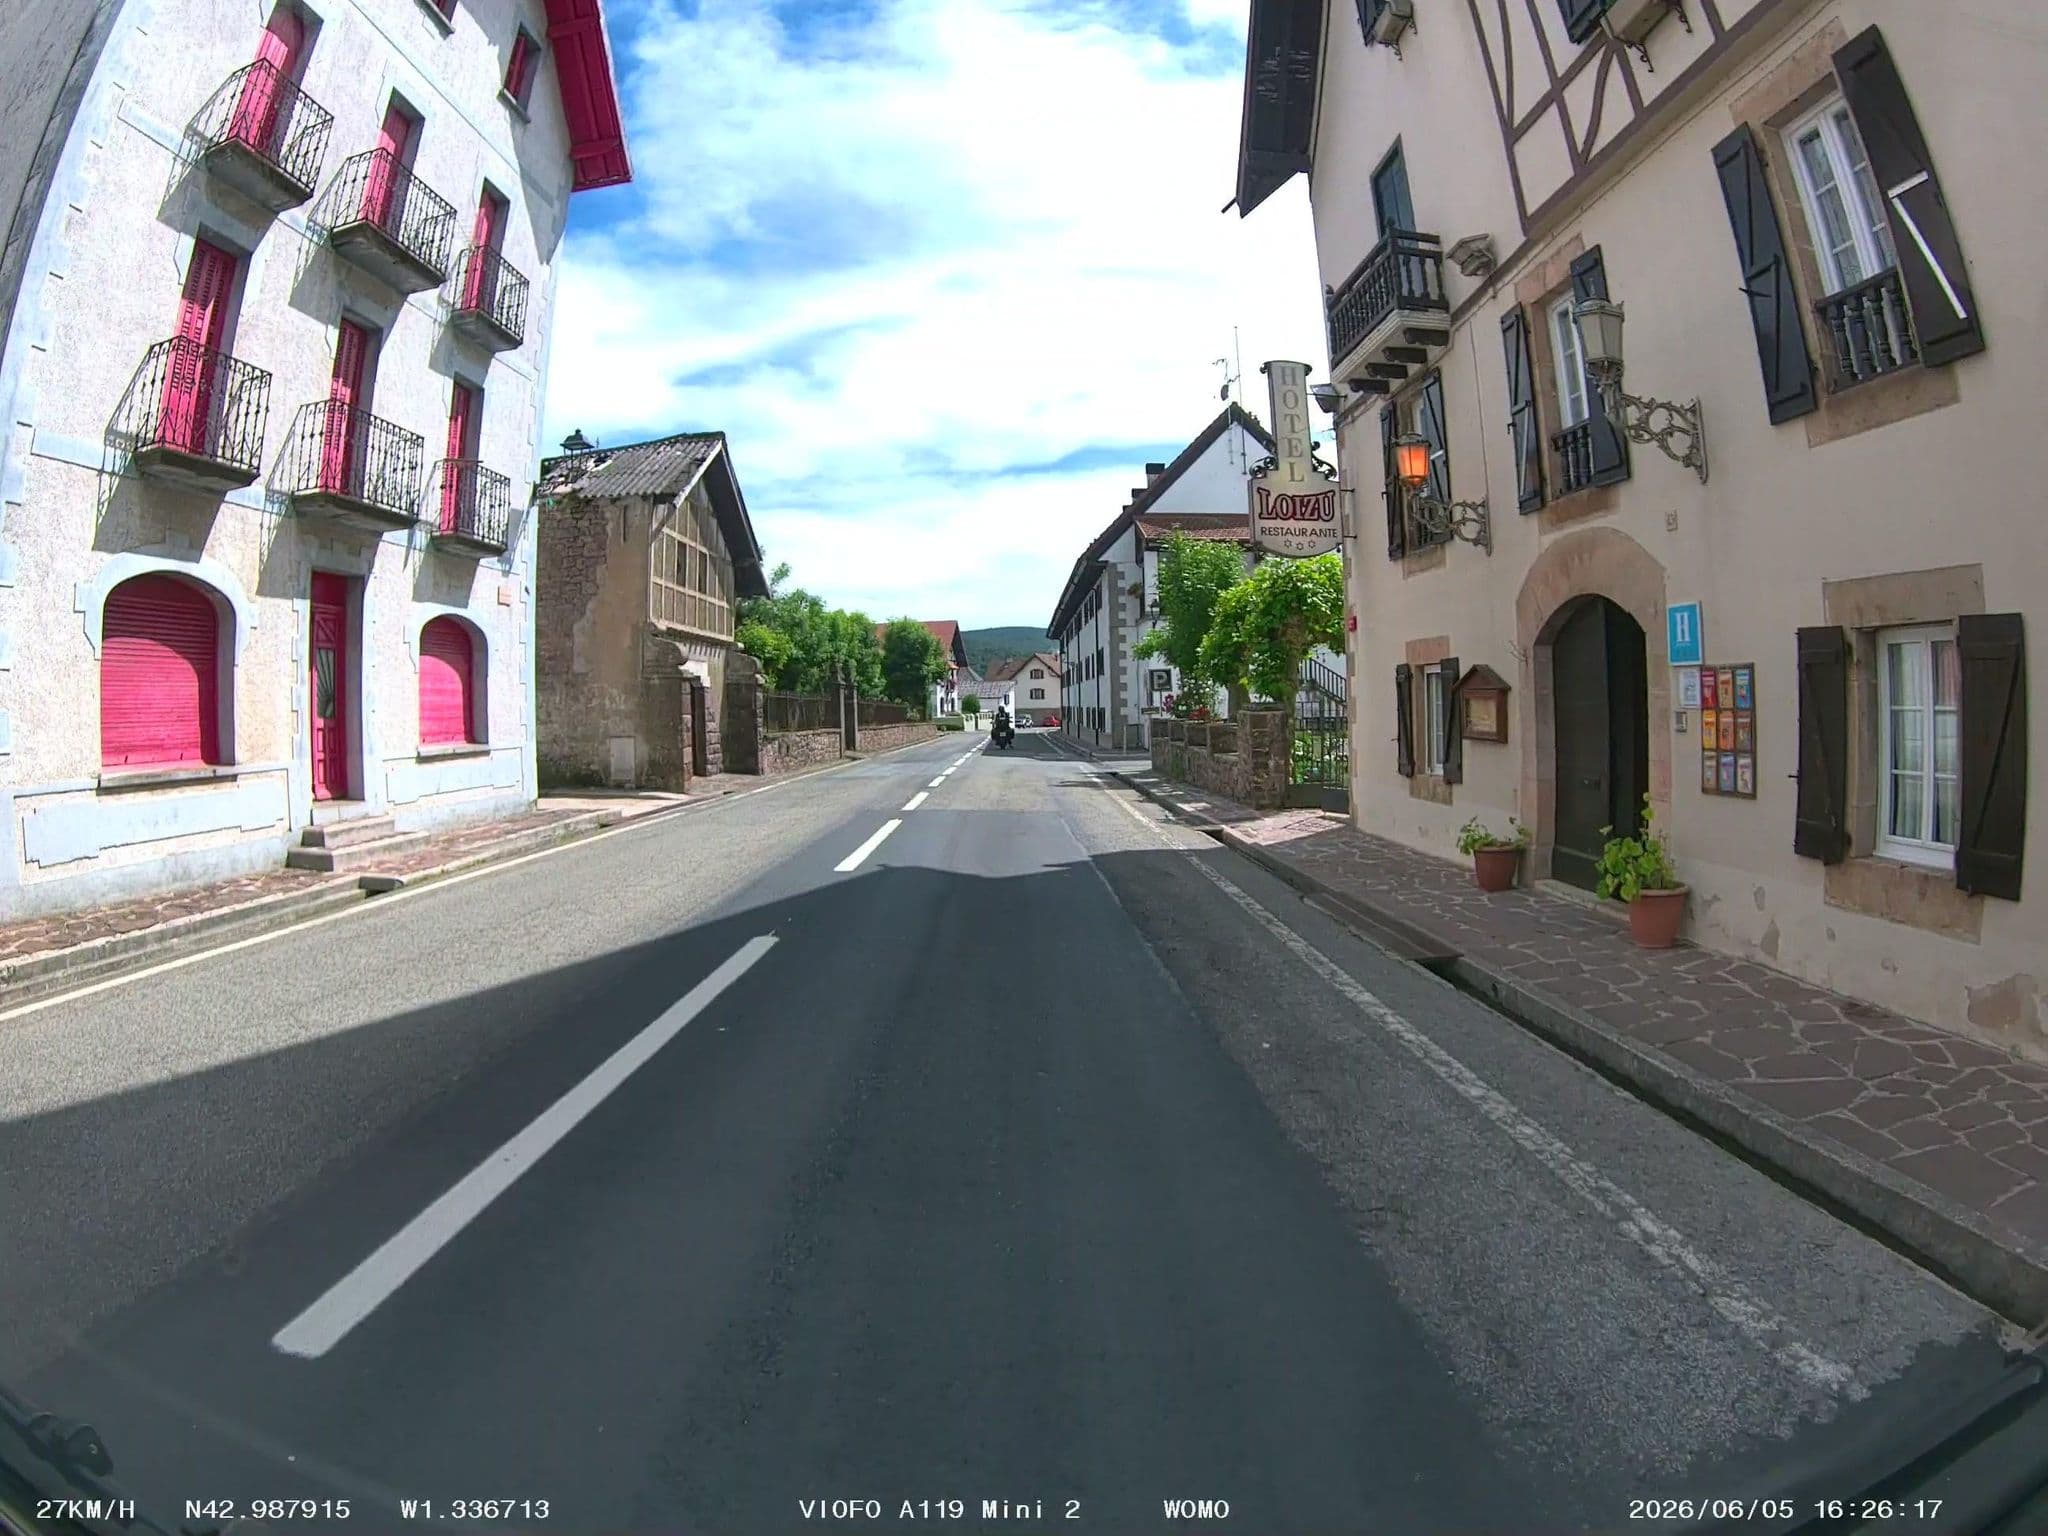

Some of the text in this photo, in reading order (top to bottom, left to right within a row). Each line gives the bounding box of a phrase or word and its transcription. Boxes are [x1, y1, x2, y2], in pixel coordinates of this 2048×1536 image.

[1278, 366, 1305, 483] HOTEL
[1257, 487, 1336, 522] LOIZU
[1260, 527, 1338, 539] RESTAURANTE
[1675, 611, 1692, 642] H
[1153, 671, 1168, 690] P
